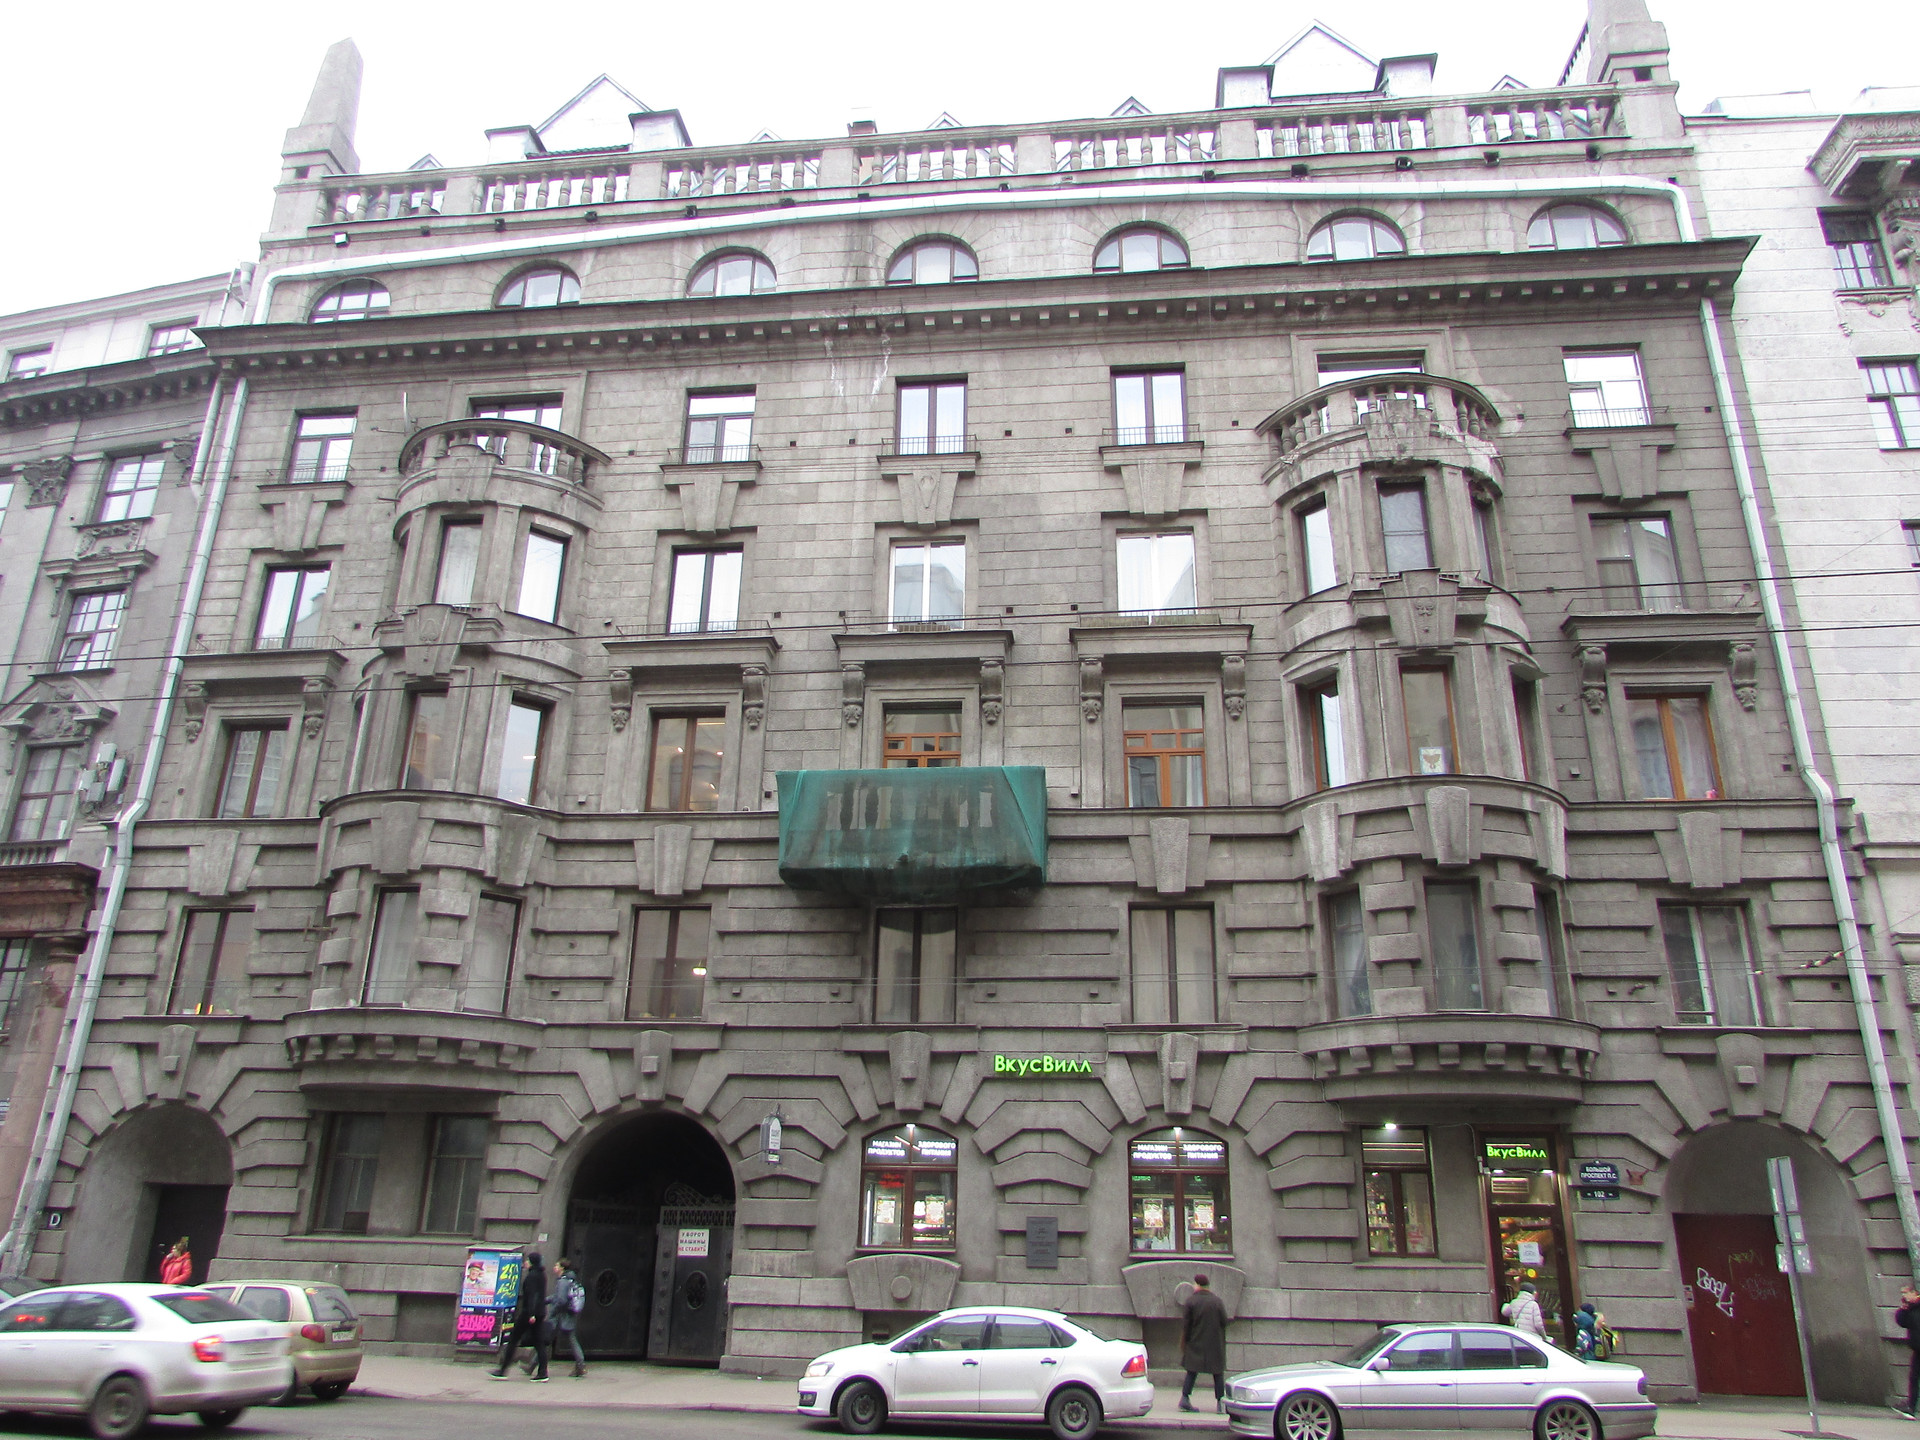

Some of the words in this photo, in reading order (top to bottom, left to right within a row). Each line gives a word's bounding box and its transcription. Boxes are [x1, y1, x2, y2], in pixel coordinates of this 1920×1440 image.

[994, 1054, 1092, 1076] ВкусВилл
[872, 1140, 902, 1148] МАГАЗИН
[918, 1140, 956, 1149] ЗДОРОВОГО
[867, 1148, 906, 1157] ПРОДУКТОВ
[1486, 1145, 1547, 1160] ВкусВилл
[458, 1314, 496, 1324] ESKIMO
